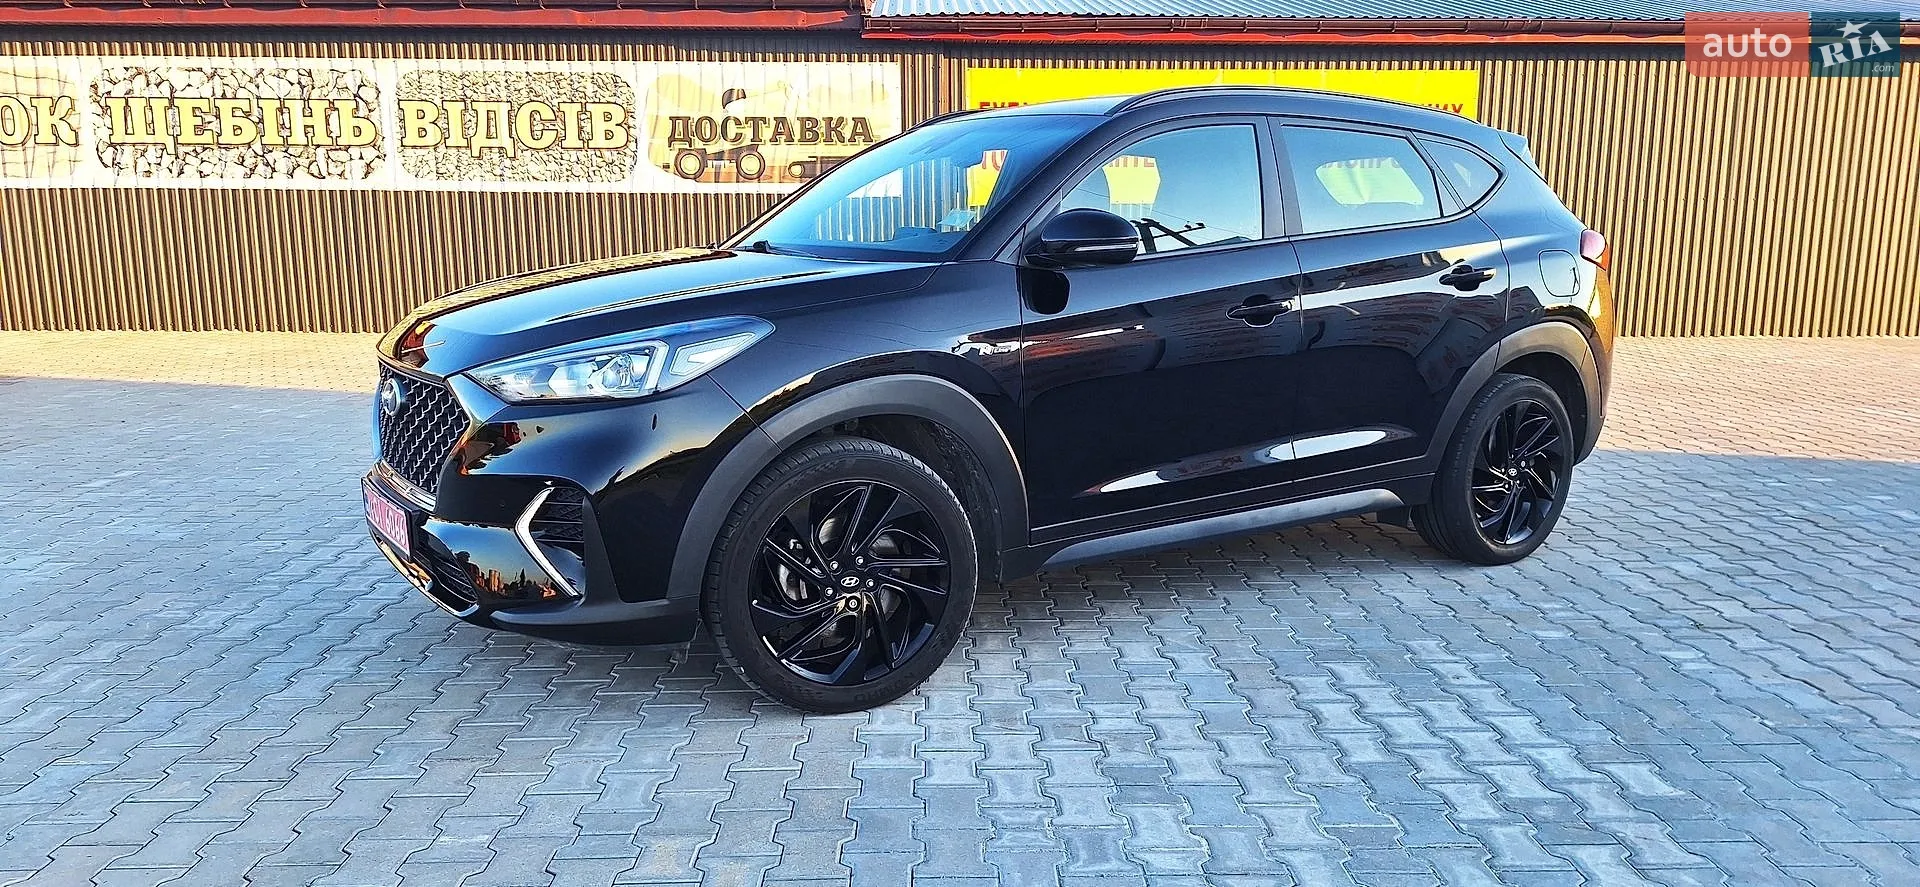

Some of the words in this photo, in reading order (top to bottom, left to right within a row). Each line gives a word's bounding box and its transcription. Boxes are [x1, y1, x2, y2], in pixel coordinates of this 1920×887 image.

[105, 96, 378, 155] ЩЕБІНЬ
[398, 99, 631, 158] ВІДСІВ
[668, 116, 874, 148] ДОСТАВКА
